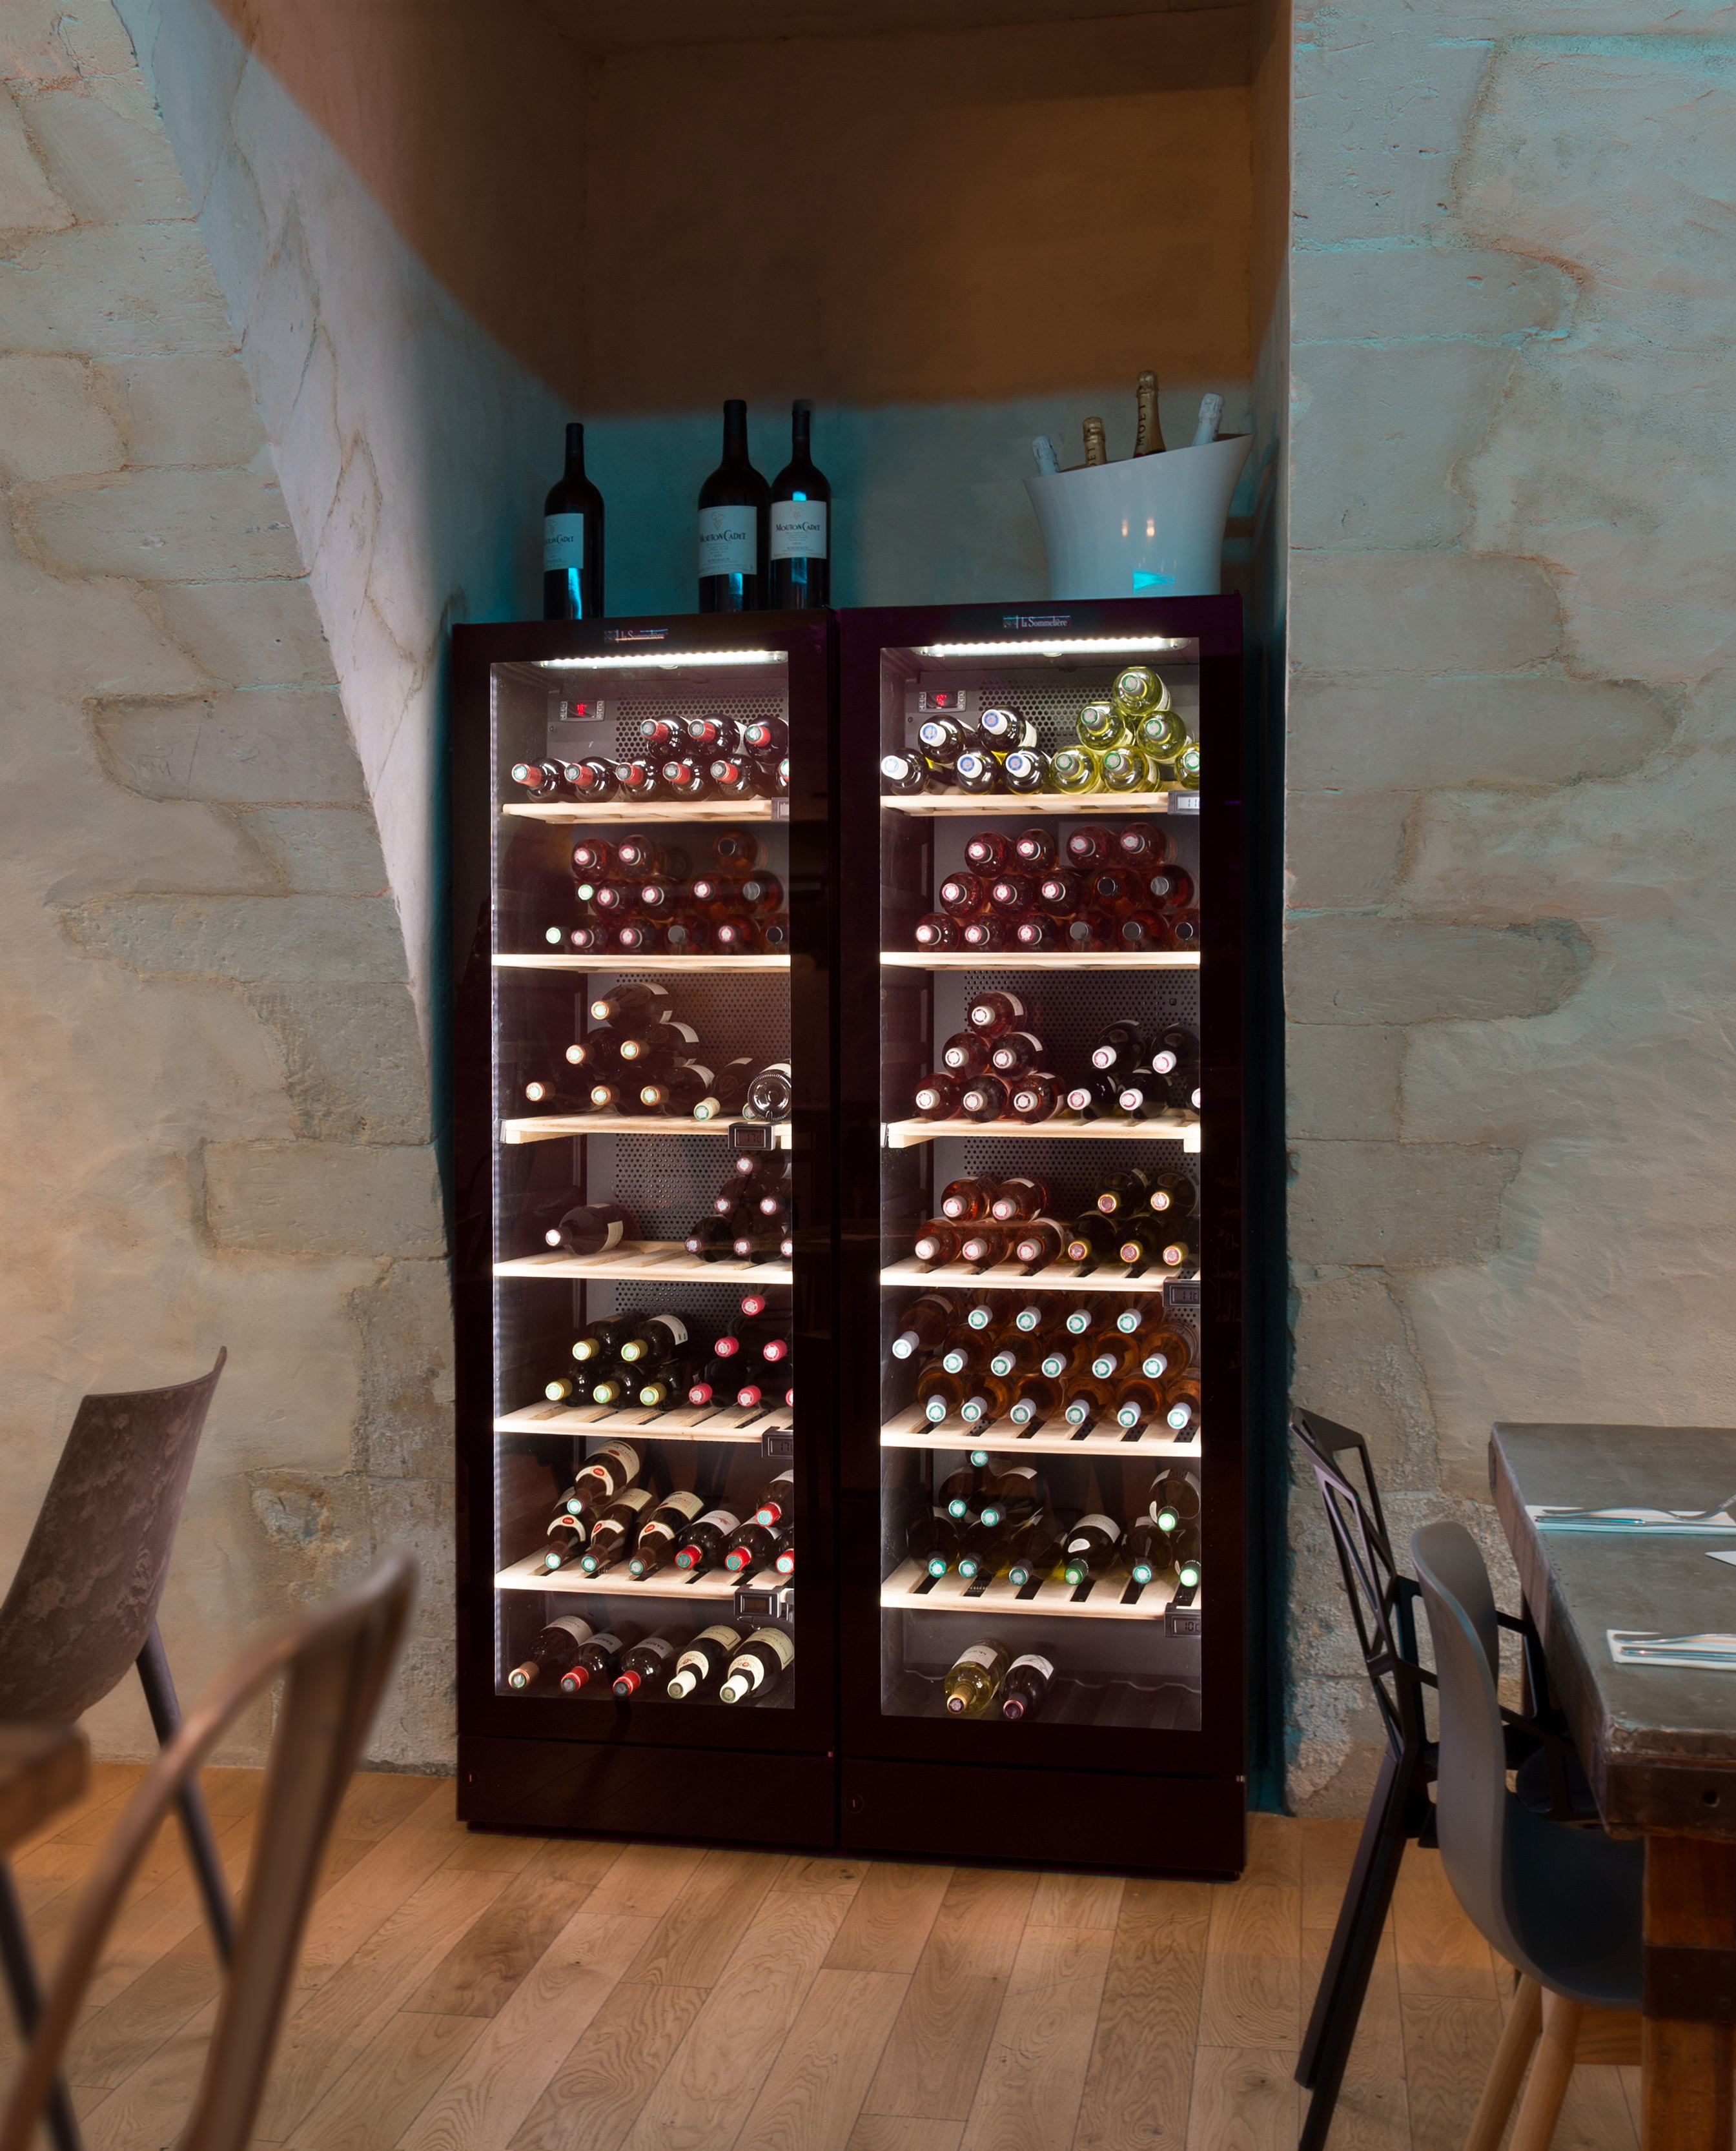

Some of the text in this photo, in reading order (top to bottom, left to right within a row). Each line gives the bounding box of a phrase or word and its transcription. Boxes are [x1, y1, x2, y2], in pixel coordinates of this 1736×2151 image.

[776, 522, 820, 531] MOUTON CADET
[557, 534, 574, 544] CADET
[699, 529, 746, 544] MOUTON CADET
[1028, 616, 1067, 627] Sommelière
